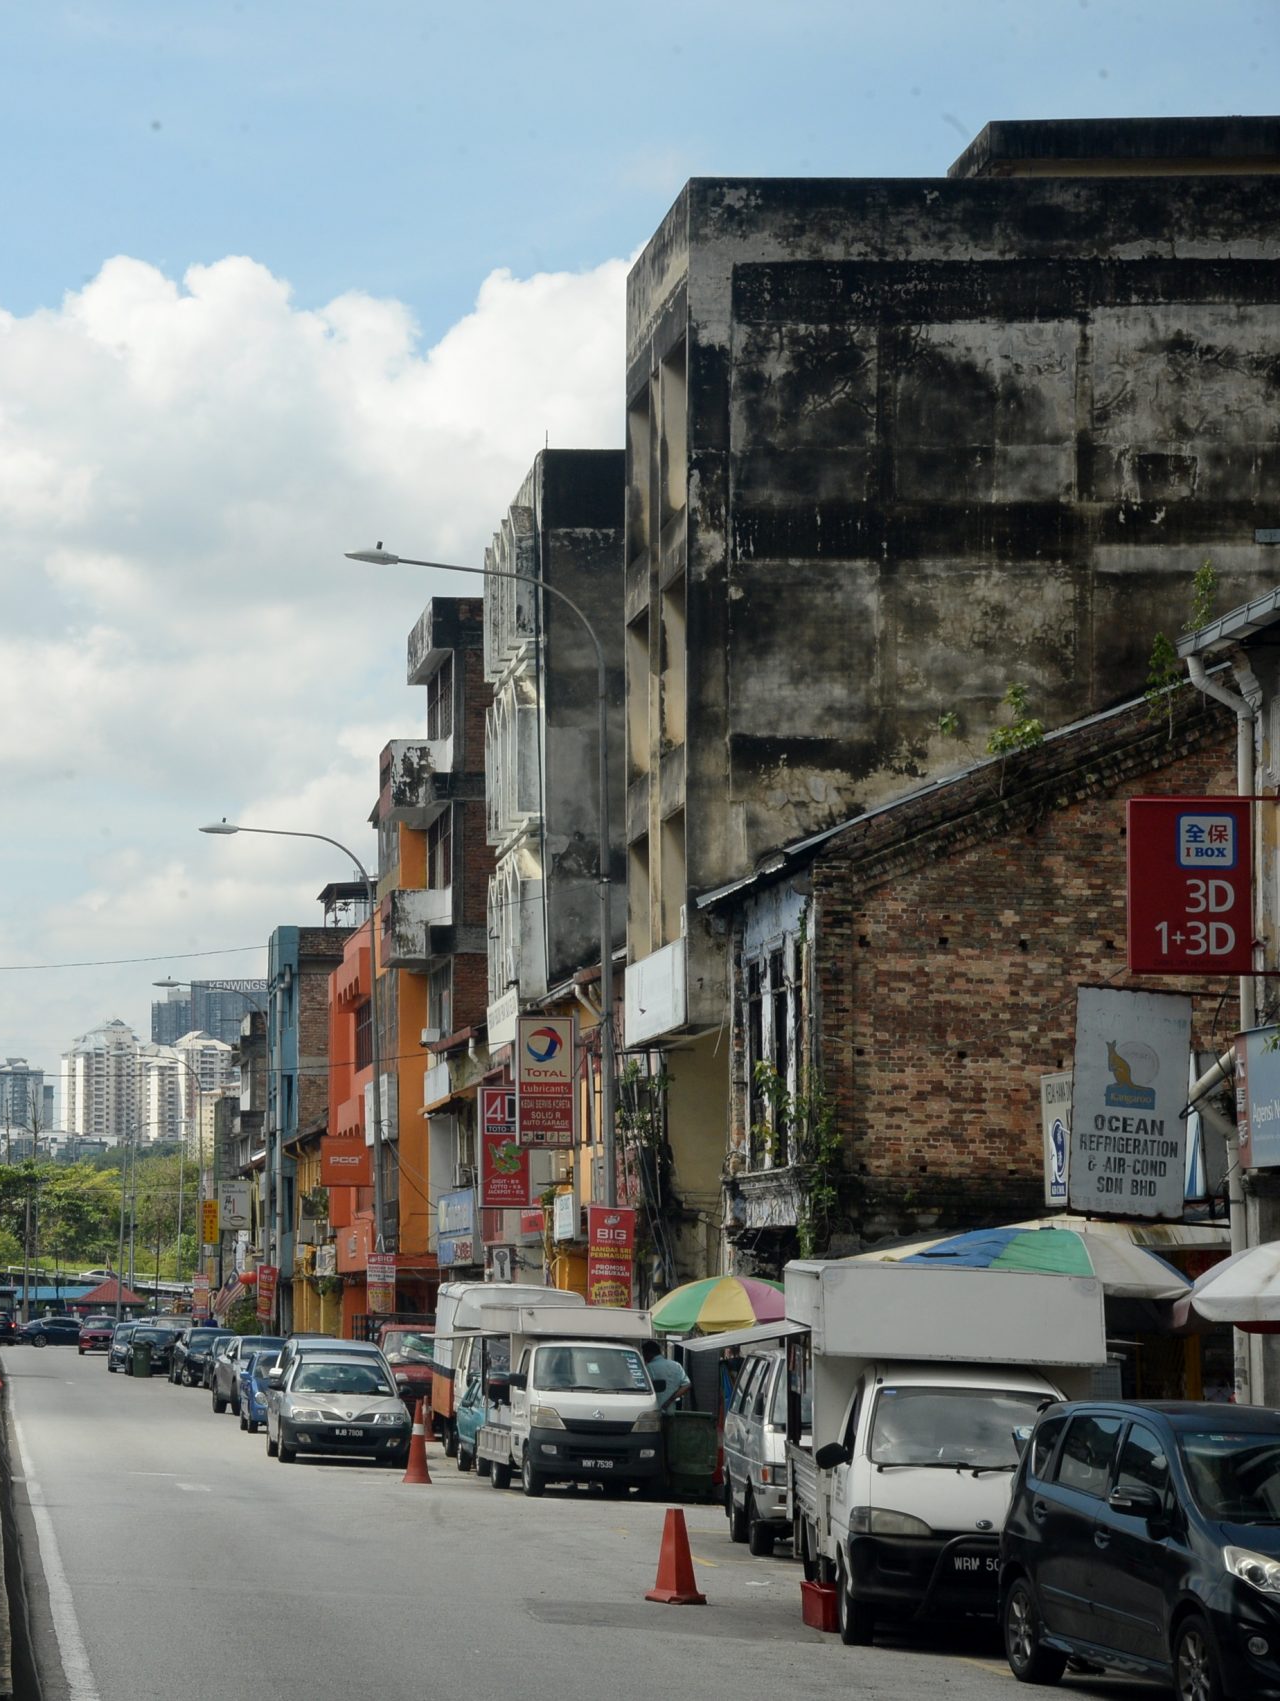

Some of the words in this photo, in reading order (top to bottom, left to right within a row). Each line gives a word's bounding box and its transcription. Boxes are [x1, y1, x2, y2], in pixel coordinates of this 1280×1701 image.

[1185, 824, 1229, 844] 全保
[1185, 847, 1191, 857] I
[1194, 847, 1227, 858] BOX
[1185, 878, 1236, 914] 3D
[1154, 920, 1237, 956] 1+3D
[524, 1068, 567, 1078] TOTAL
[522, 1084, 569, 1094] Lubricants
[1110, 1093, 1153, 1105] Kangaroo
[531, 1111, 553, 1119] SOLID
[555, 1111, 561, 1119] R
[1252, 1100, 1274, 1129] Agensi
[487, 1125, 508, 1133] TOTO
[522, 1119, 541, 1127] AUTO
[542, 1119, 570, 1128] GARAGE
[1093, 1114, 1165, 1136] OCEAN
[1079, 1133, 1179, 1158] REFRIGERATION
[1104, 1156, 1167, 1177] AIR-COND
[1096, 1176, 1123, 1195] SDN
[1131, 1179, 1158, 1197] BHD
[596, 1228, 627, 1241] BIG
[591, 1269, 630, 1277] PEMBUKAAN
[594, 1290, 626, 1299] HARGA
[596, 1459, 614, 1469] 7539
[953, 1557, 980, 1571] WRM
